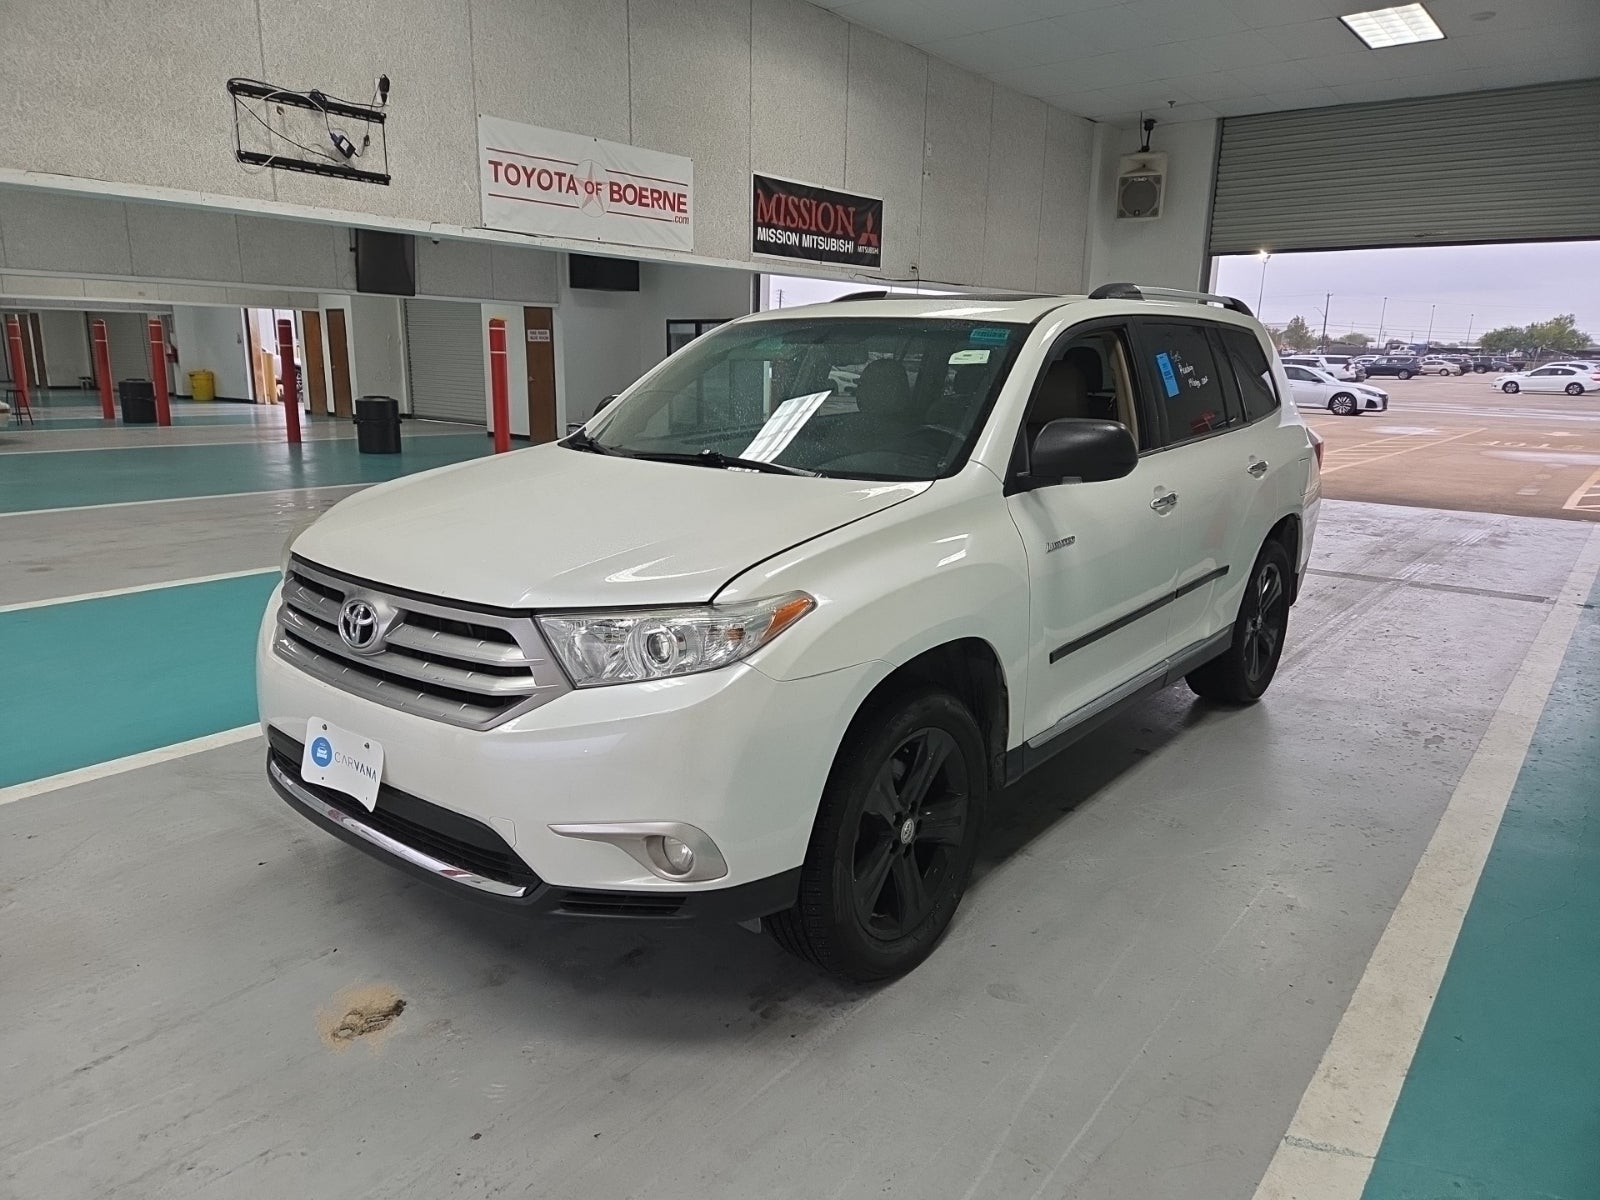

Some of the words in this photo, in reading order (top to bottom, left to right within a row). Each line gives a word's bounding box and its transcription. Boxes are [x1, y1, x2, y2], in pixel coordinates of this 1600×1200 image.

[488, 159, 579, 196] TOYOTA
[584, 180, 603, 196] OF
[609, 180, 688, 214] BOERNE
[672, 215, 690, 225] .com
[757, 188, 856, 238] MISSION
[757, 226, 800, 247] MISSION
[801, 233, 855, 254] MITSUBISHI
[857, 245, 879, 255] MITSUBISHI
[334, 751, 377, 783] CARVANA
